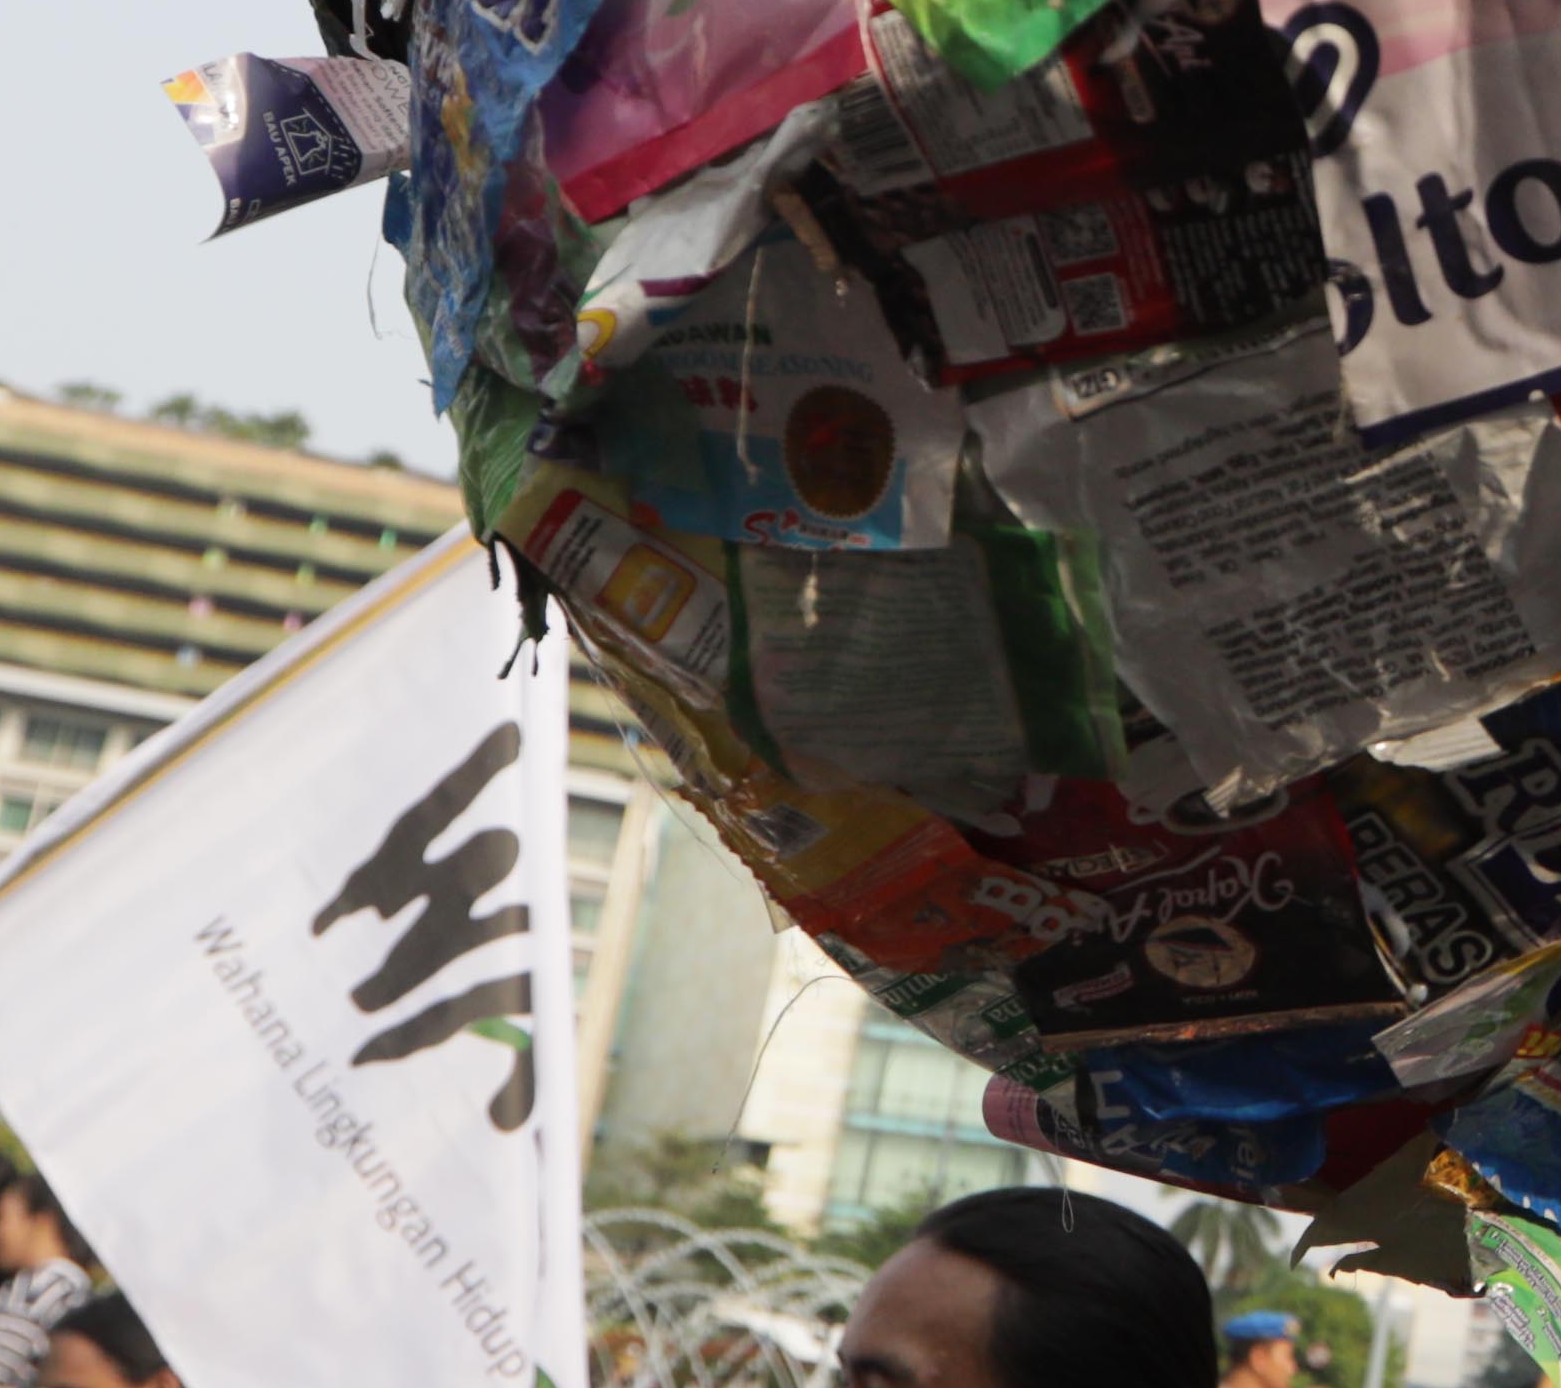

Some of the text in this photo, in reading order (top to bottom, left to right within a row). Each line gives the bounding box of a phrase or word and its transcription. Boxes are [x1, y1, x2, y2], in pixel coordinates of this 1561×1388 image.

[272, 145, 298, 187] APEK
[1157, 850, 1296, 924] Kapal
[193, 913, 527, 1382] Wahana Lingkungan Hidup
